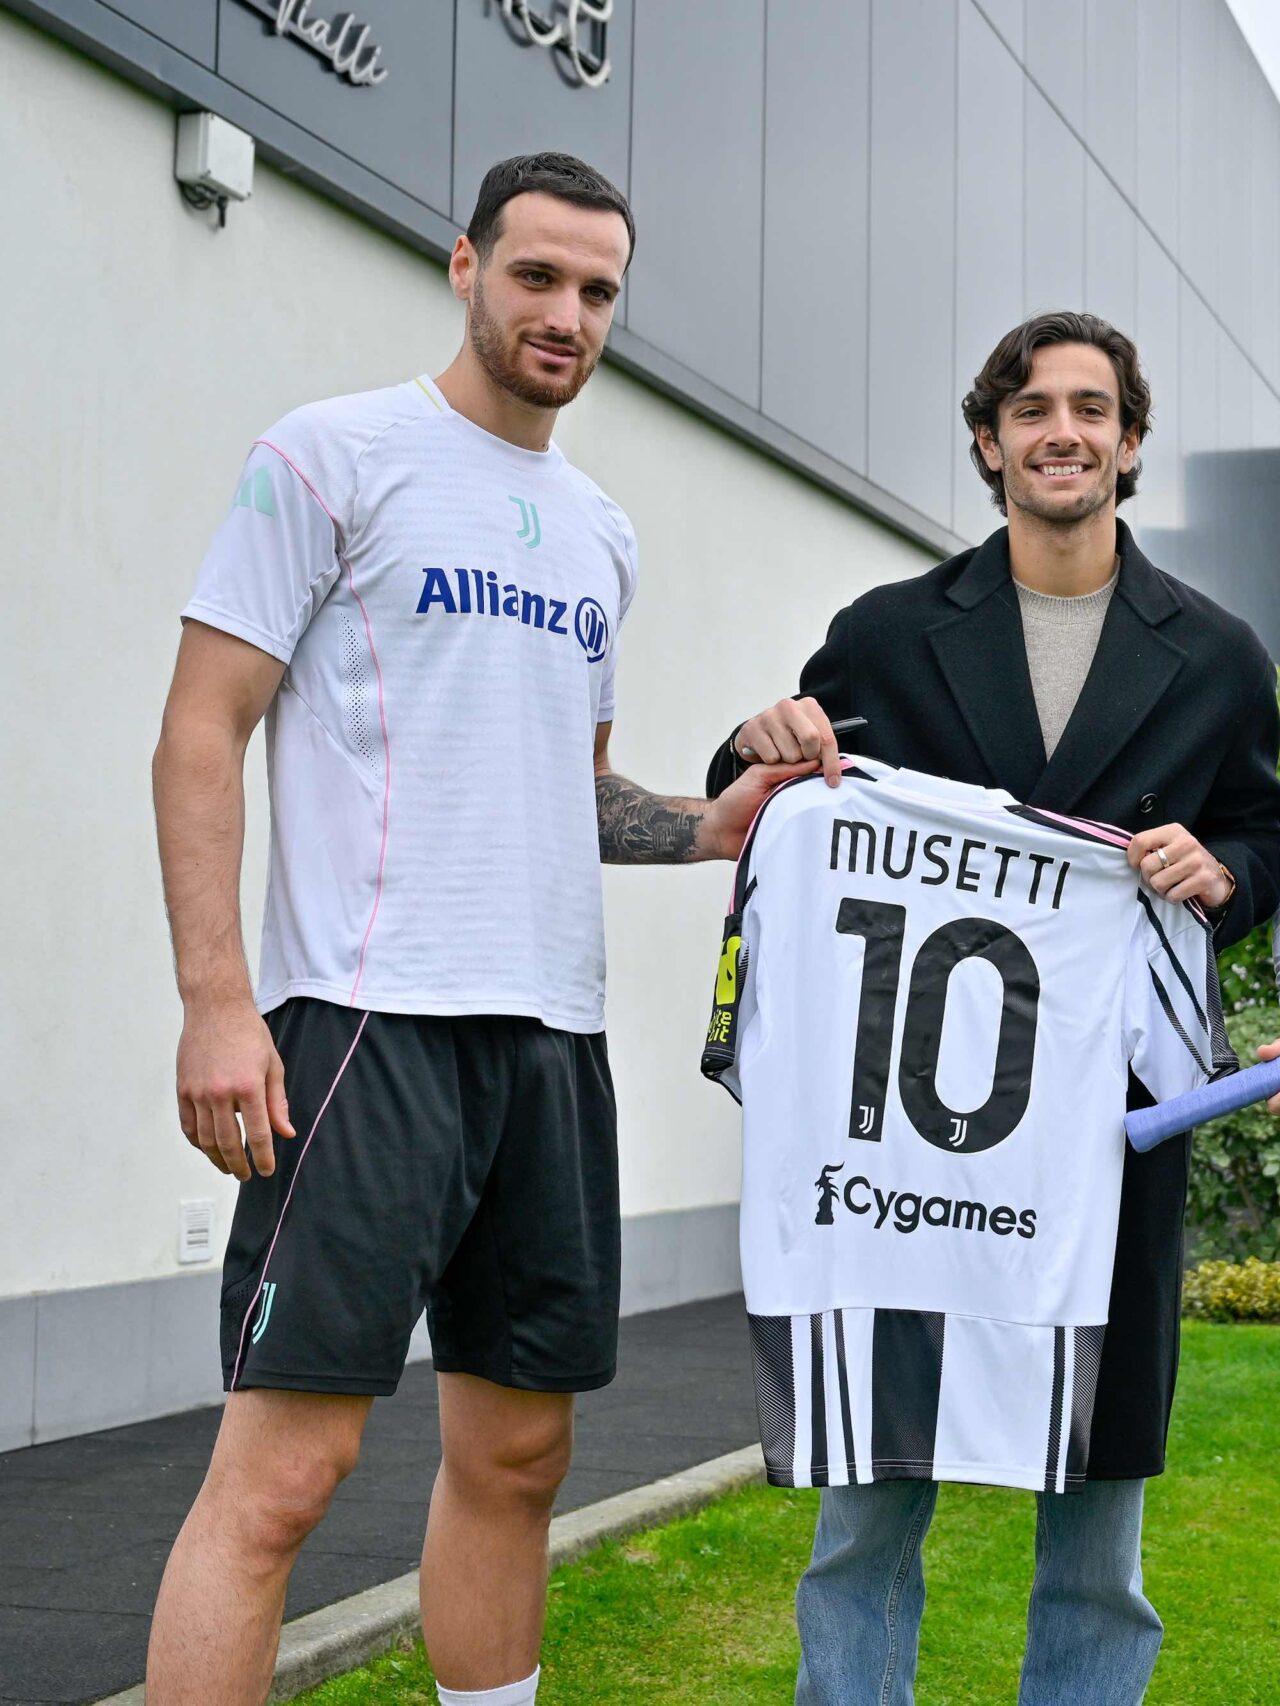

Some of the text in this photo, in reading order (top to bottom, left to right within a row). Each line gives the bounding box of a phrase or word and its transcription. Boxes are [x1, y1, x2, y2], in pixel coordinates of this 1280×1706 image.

[415, 566, 568, 635] Allianz
[829, 818, 1071, 910] MUSETTI
[835, 897, 1041, 1154] 10
[842, 1175, 1038, 1240] Cygames
